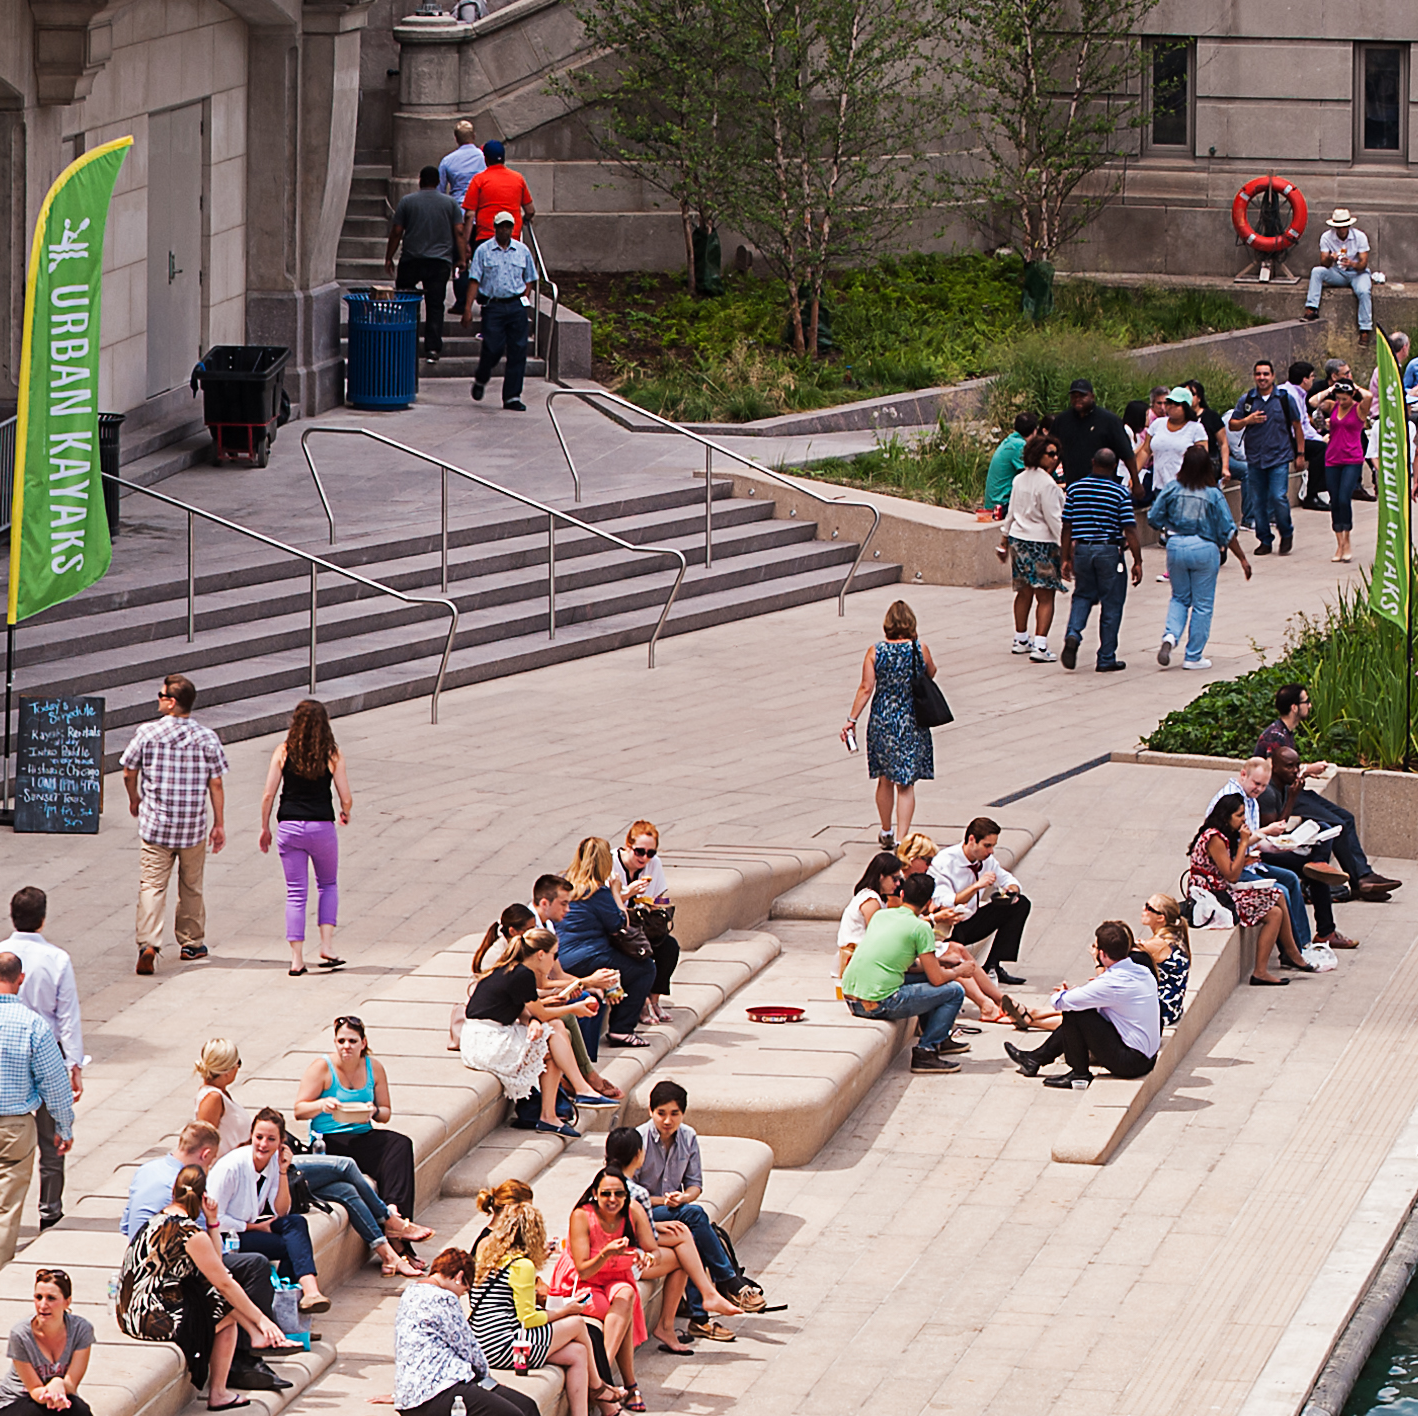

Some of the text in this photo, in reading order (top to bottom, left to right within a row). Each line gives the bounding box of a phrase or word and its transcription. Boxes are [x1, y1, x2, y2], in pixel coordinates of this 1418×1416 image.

[49, 284, 92, 575] URBAN KAYAKS
[28, 699, 69, 715] Today's
[68, 725, 101, 738] Rentals
[28, 746, 58, 757] Intro
[27, 762, 100, 779] Historic Chicago
